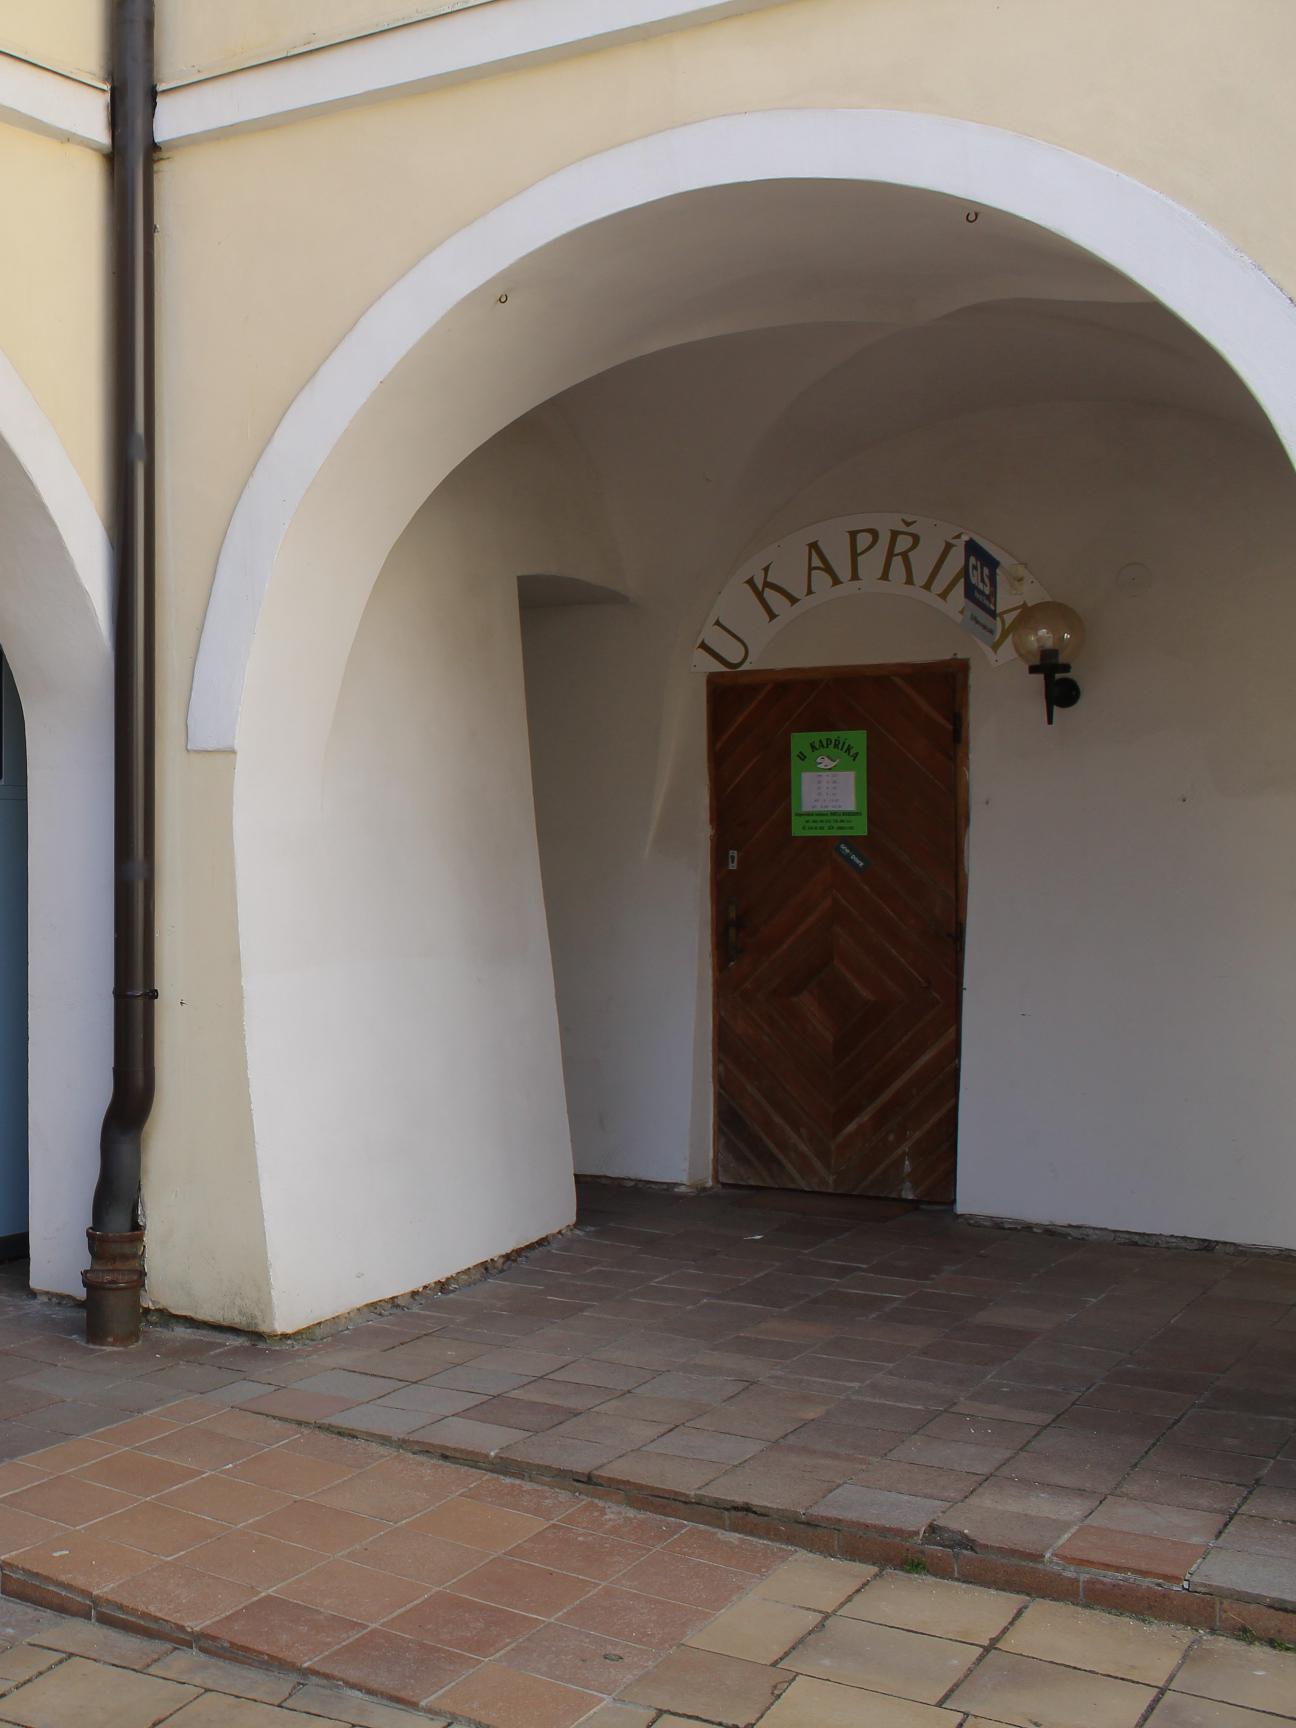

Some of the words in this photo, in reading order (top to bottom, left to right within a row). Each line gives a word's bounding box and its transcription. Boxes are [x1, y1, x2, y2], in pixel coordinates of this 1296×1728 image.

[968, 555, 990, 595] GLS
[696, 617, 749, 670] U
[796, 750, 807, 762] U
[809, 736, 859, 762] KAPŘÍKA
